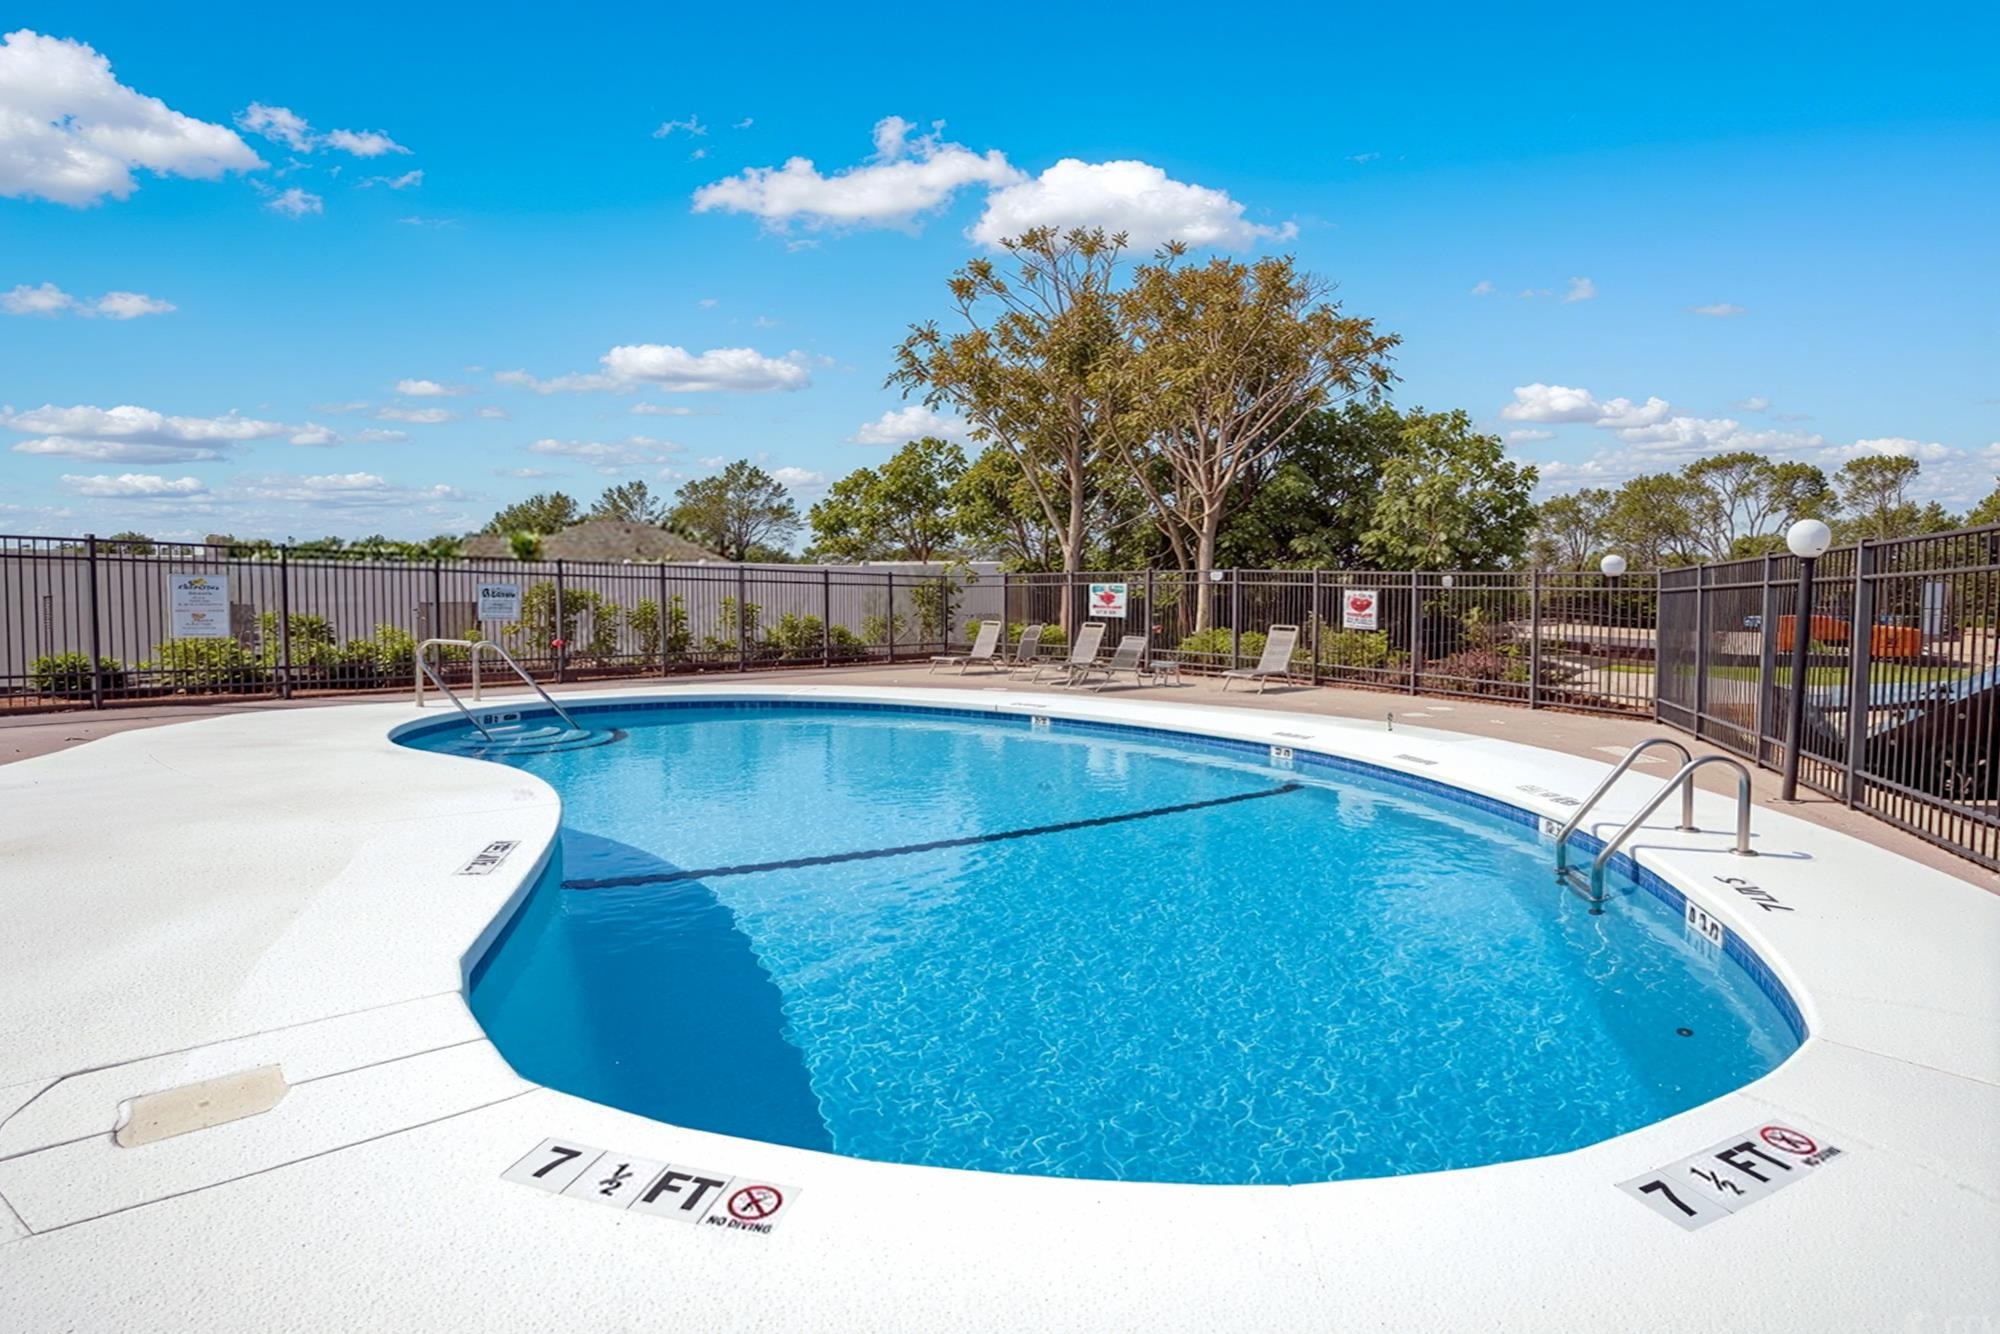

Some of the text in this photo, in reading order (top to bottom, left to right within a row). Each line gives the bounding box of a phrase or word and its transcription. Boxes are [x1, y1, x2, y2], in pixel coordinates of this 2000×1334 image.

[532, 1146, 582, 1178] 7
[641, 1170, 726, 1211] FT
[1638, 1179, 1698, 1217] 7
[1714, 1141, 1792, 1183] FT
[706, 1215, 773, 1234] NO DIVING
